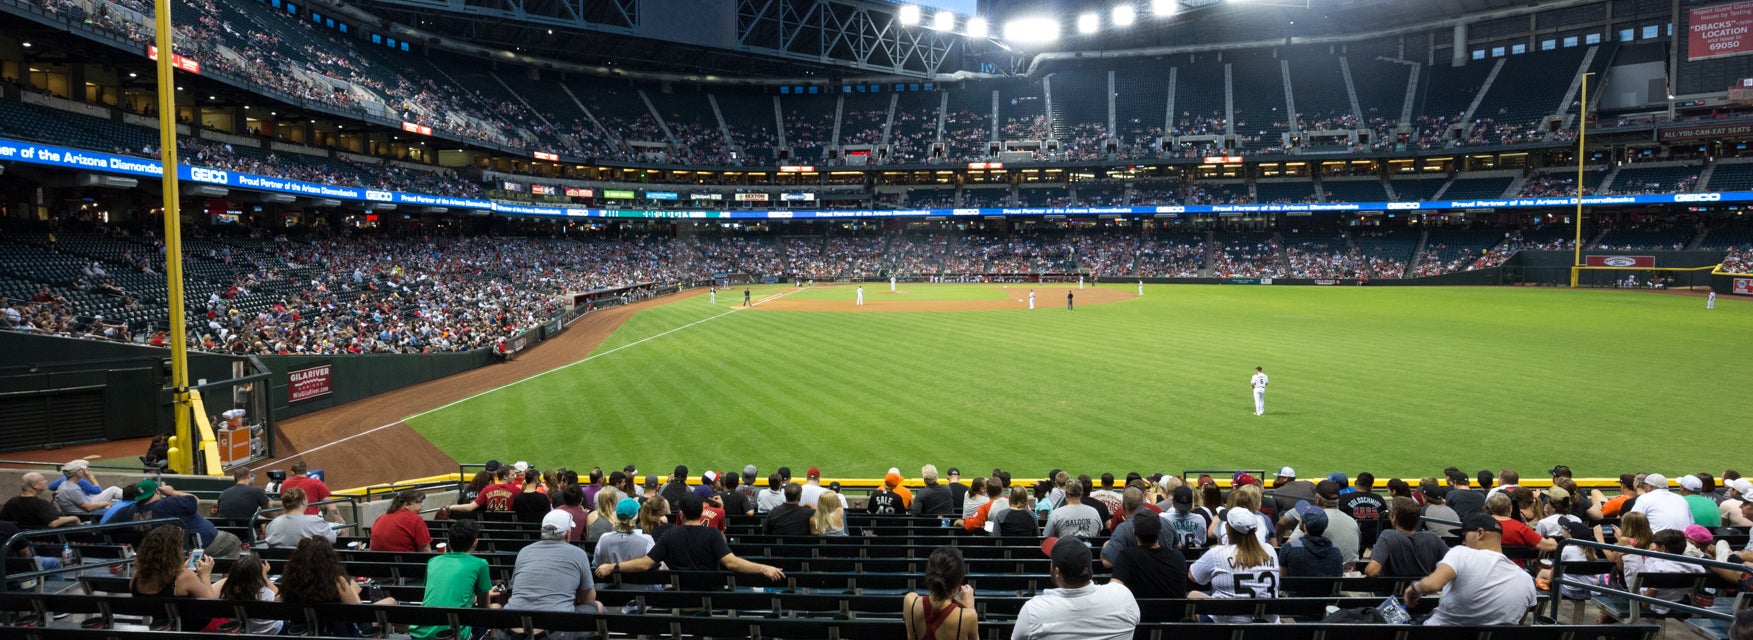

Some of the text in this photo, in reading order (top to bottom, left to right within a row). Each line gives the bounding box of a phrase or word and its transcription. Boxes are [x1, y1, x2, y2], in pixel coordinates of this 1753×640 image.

[1691, 20, 1736, 32] "DBACKS"
[1702, 26, 1747, 39] LOCATION
[1709, 40, 1740, 51] 69050
[1664, 126, 1751, 138] ALL-YOU-CAN-EAT SEATS
[0, 147, 163, 174] er of the Arizona Diamondba
[190, 168, 228, 184] GEICO
[240, 176, 259, 186] Proud
[260, 179, 283, 188] Partner
[302, 185, 320, 193] Arizona
[321, 187, 357, 197] Diamondbacks
[366, 189, 392, 201] GEICO
[1674, 193, 1720, 202] GEICO
[487, 498, 508, 511] 44
[876, 495, 893, 505] SALE
[1353, 506, 1379, 520] 44
[1233, 571, 1276, 598] 53
